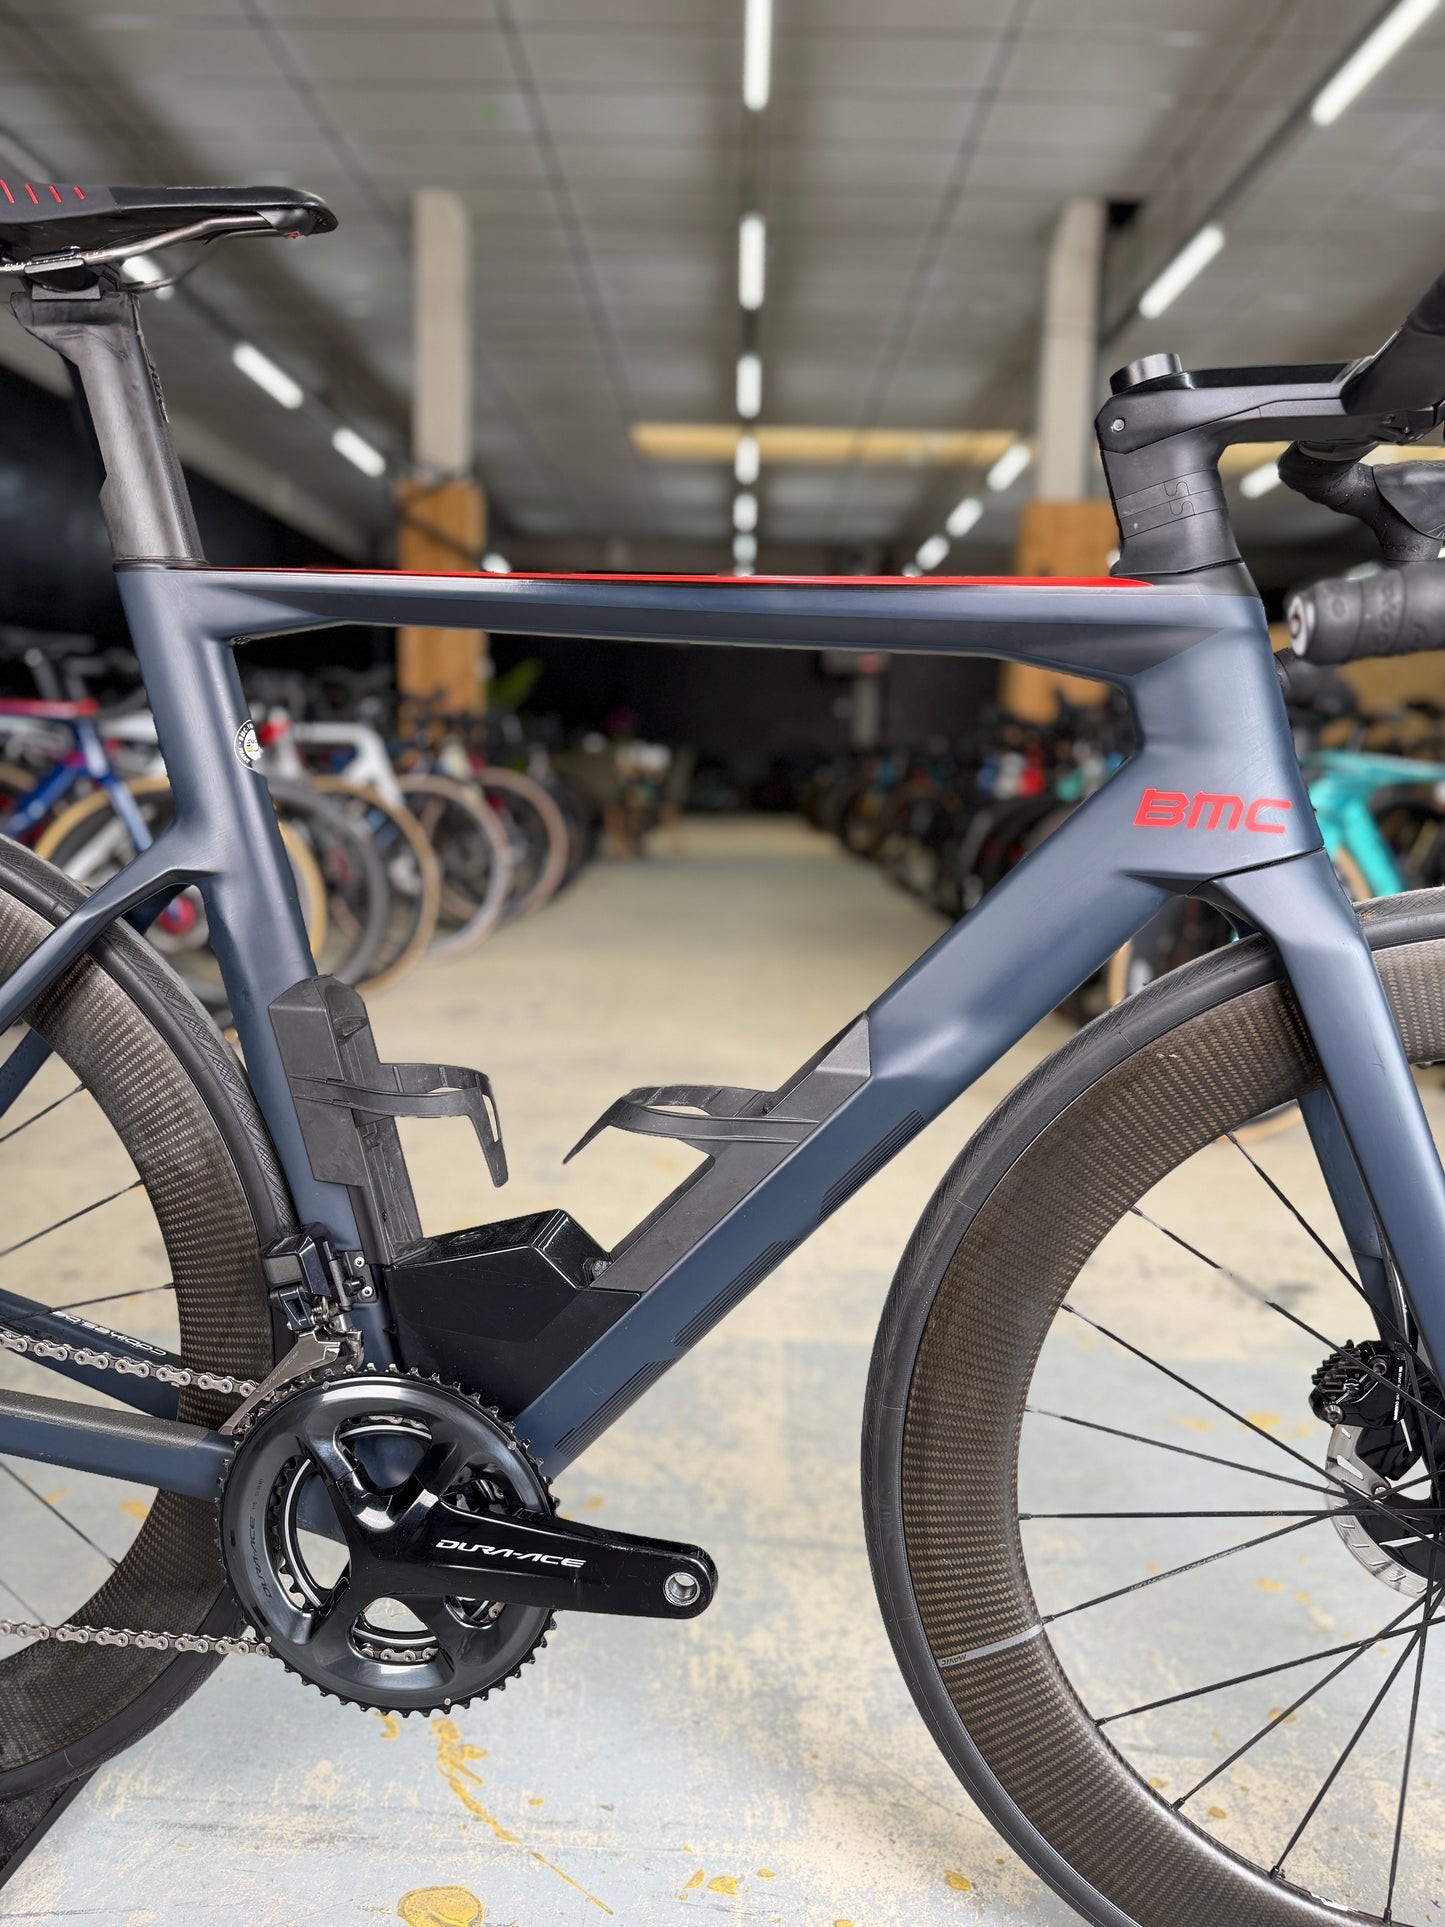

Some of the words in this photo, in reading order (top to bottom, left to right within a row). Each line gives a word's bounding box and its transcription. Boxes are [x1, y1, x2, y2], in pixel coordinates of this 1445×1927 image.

[1133, 788, 1292, 834] BMC
[249, 1515, 272, 1599] DURA-ACE
[435, 1539, 587, 1568] DURA-ACE
[941, 1653, 967, 1666] MAVIC
